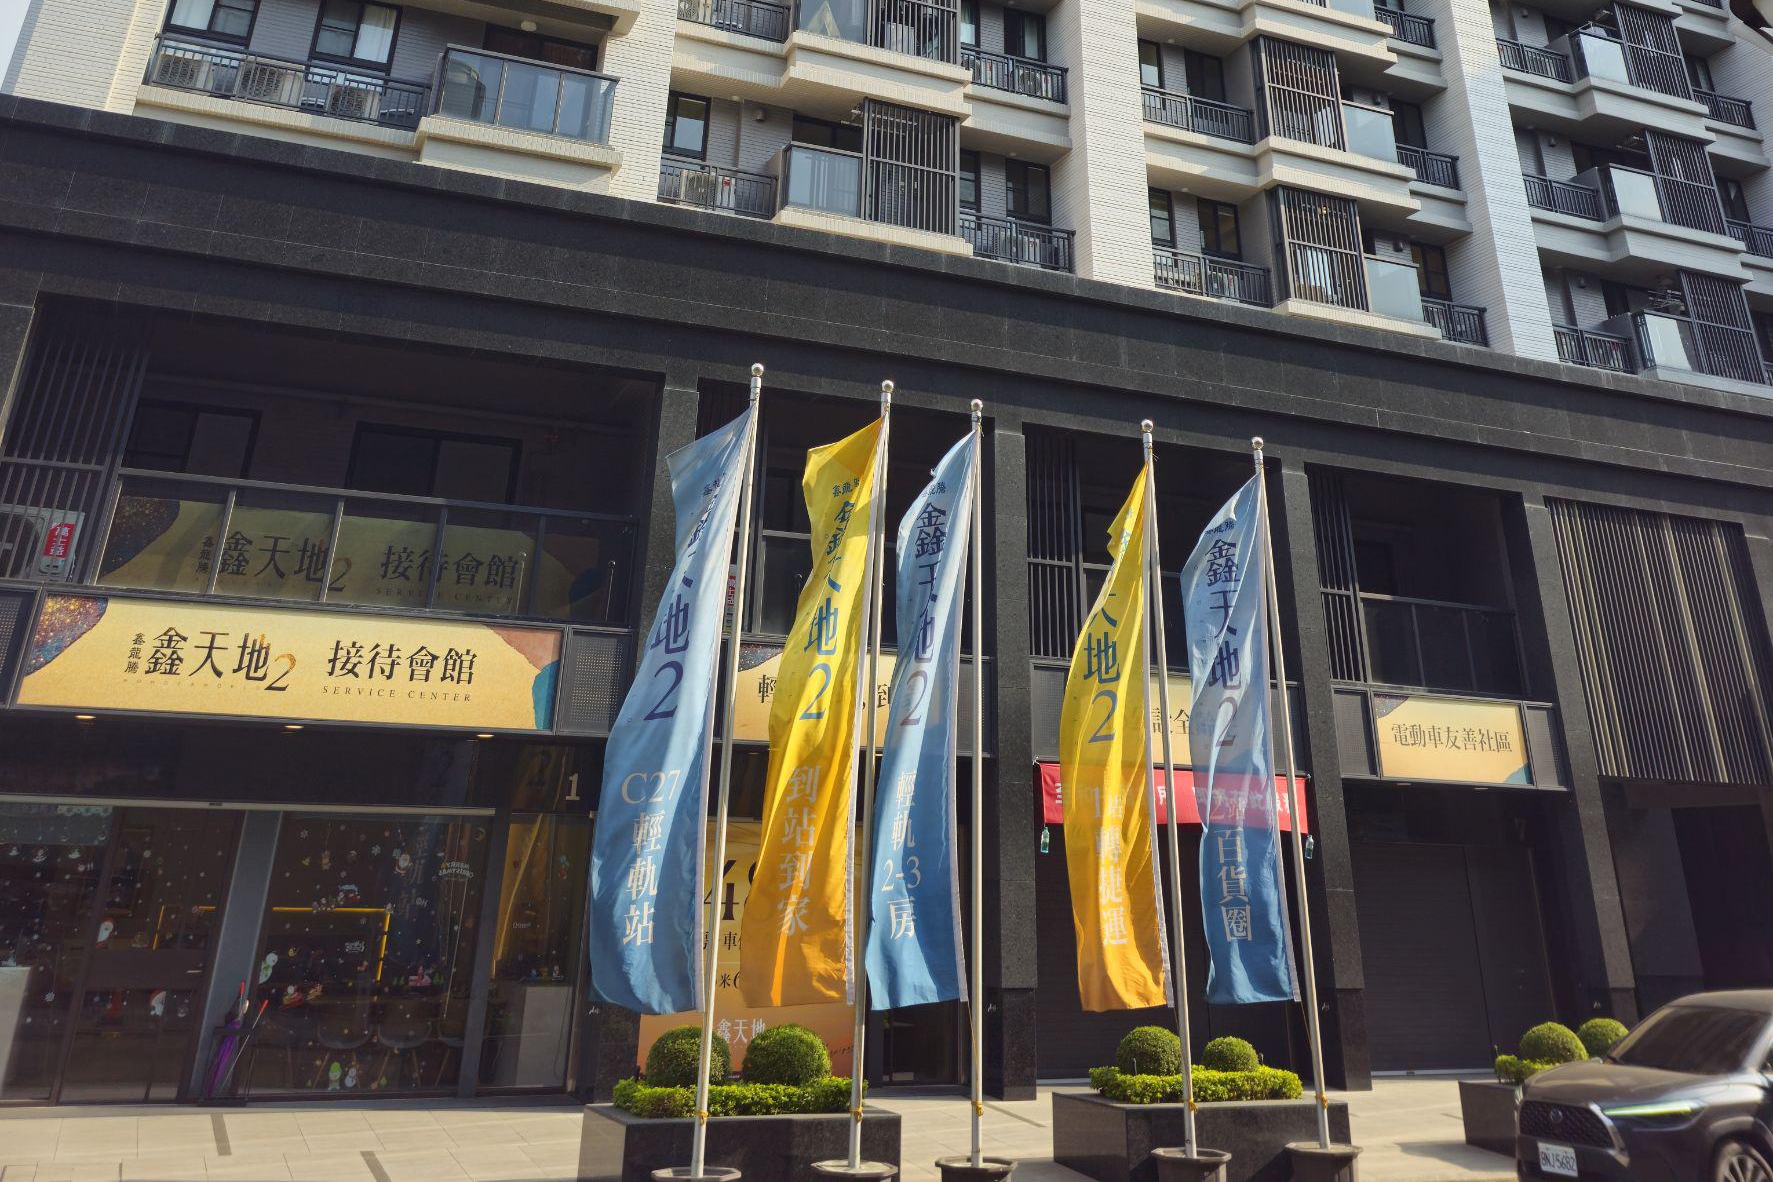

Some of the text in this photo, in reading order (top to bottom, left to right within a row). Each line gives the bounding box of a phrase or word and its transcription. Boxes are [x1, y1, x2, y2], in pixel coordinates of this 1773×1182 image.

[144, 626, 297, 692] 鑫天地2
[326, 639, 478, 685] 接待會館
[322, 685, 471, 702] SERVICE CENTER
[1391, 723, 1513, 753] 電動車友善社區
[565, 772, 580, 801] 1
[777, 765, 821, 936] 到站到家
